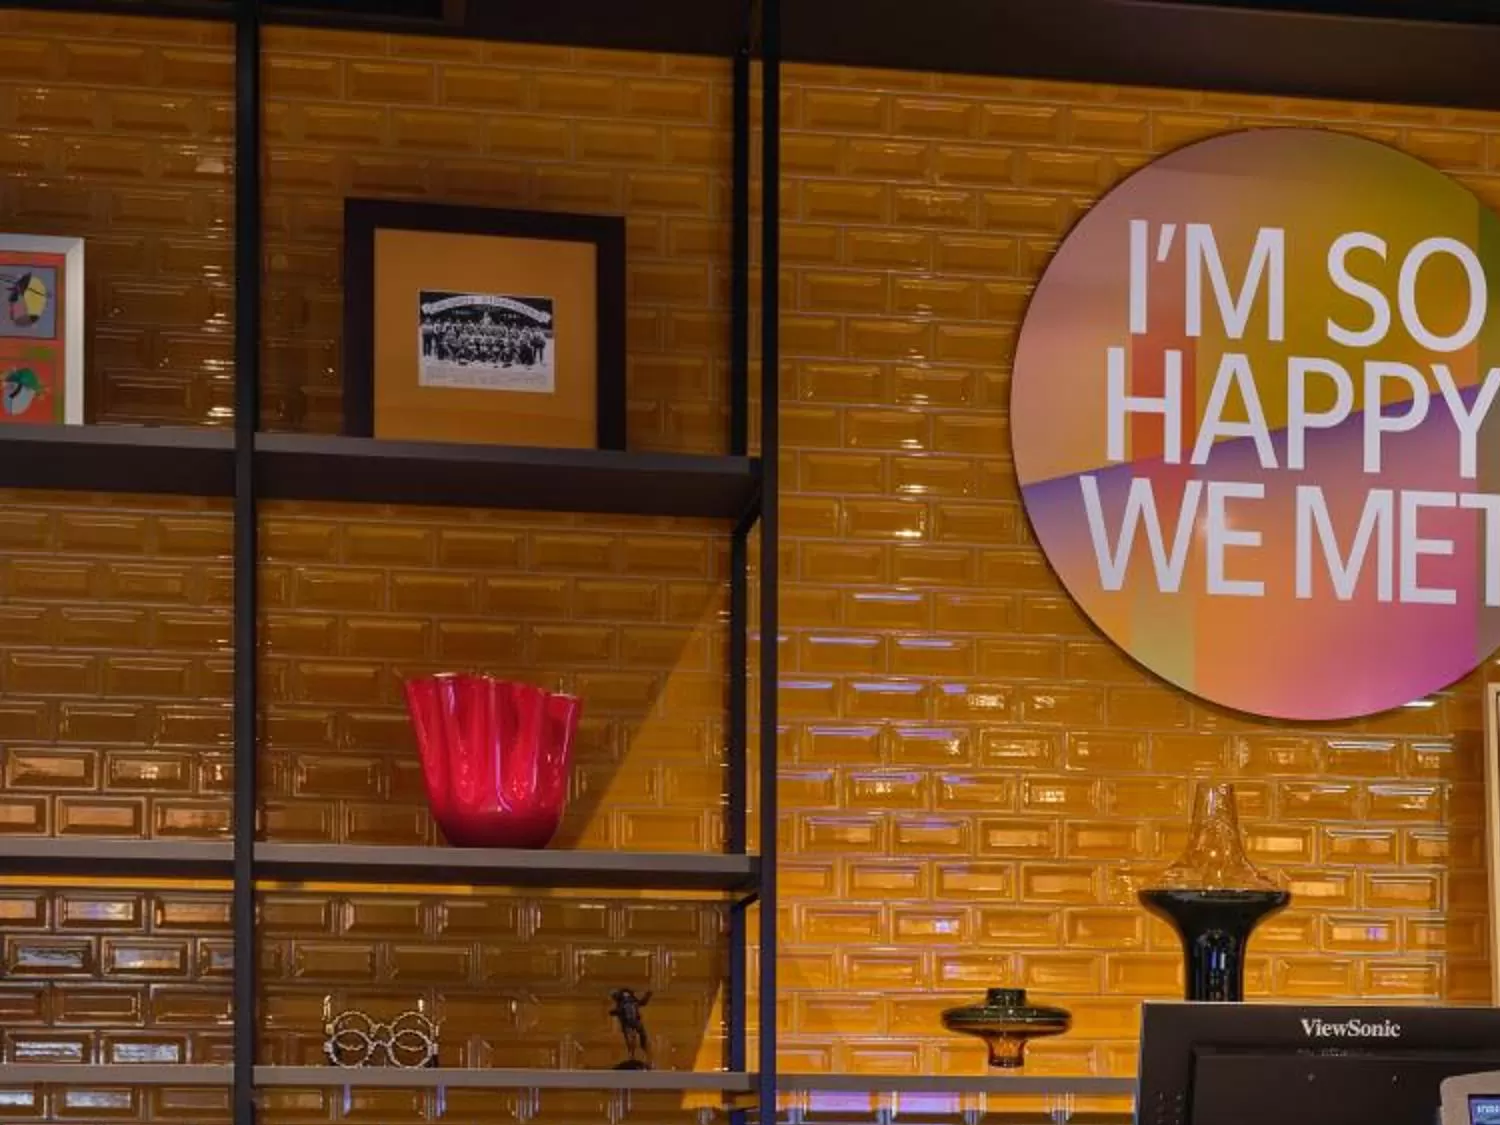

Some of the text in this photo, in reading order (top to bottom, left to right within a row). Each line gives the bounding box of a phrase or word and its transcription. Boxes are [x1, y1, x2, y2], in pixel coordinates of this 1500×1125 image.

[1326, 231, 1488, 353] SO
[1079, 474, 1266, 597] WE
[1300, 1018, 1401, 1038] ViewSonic
